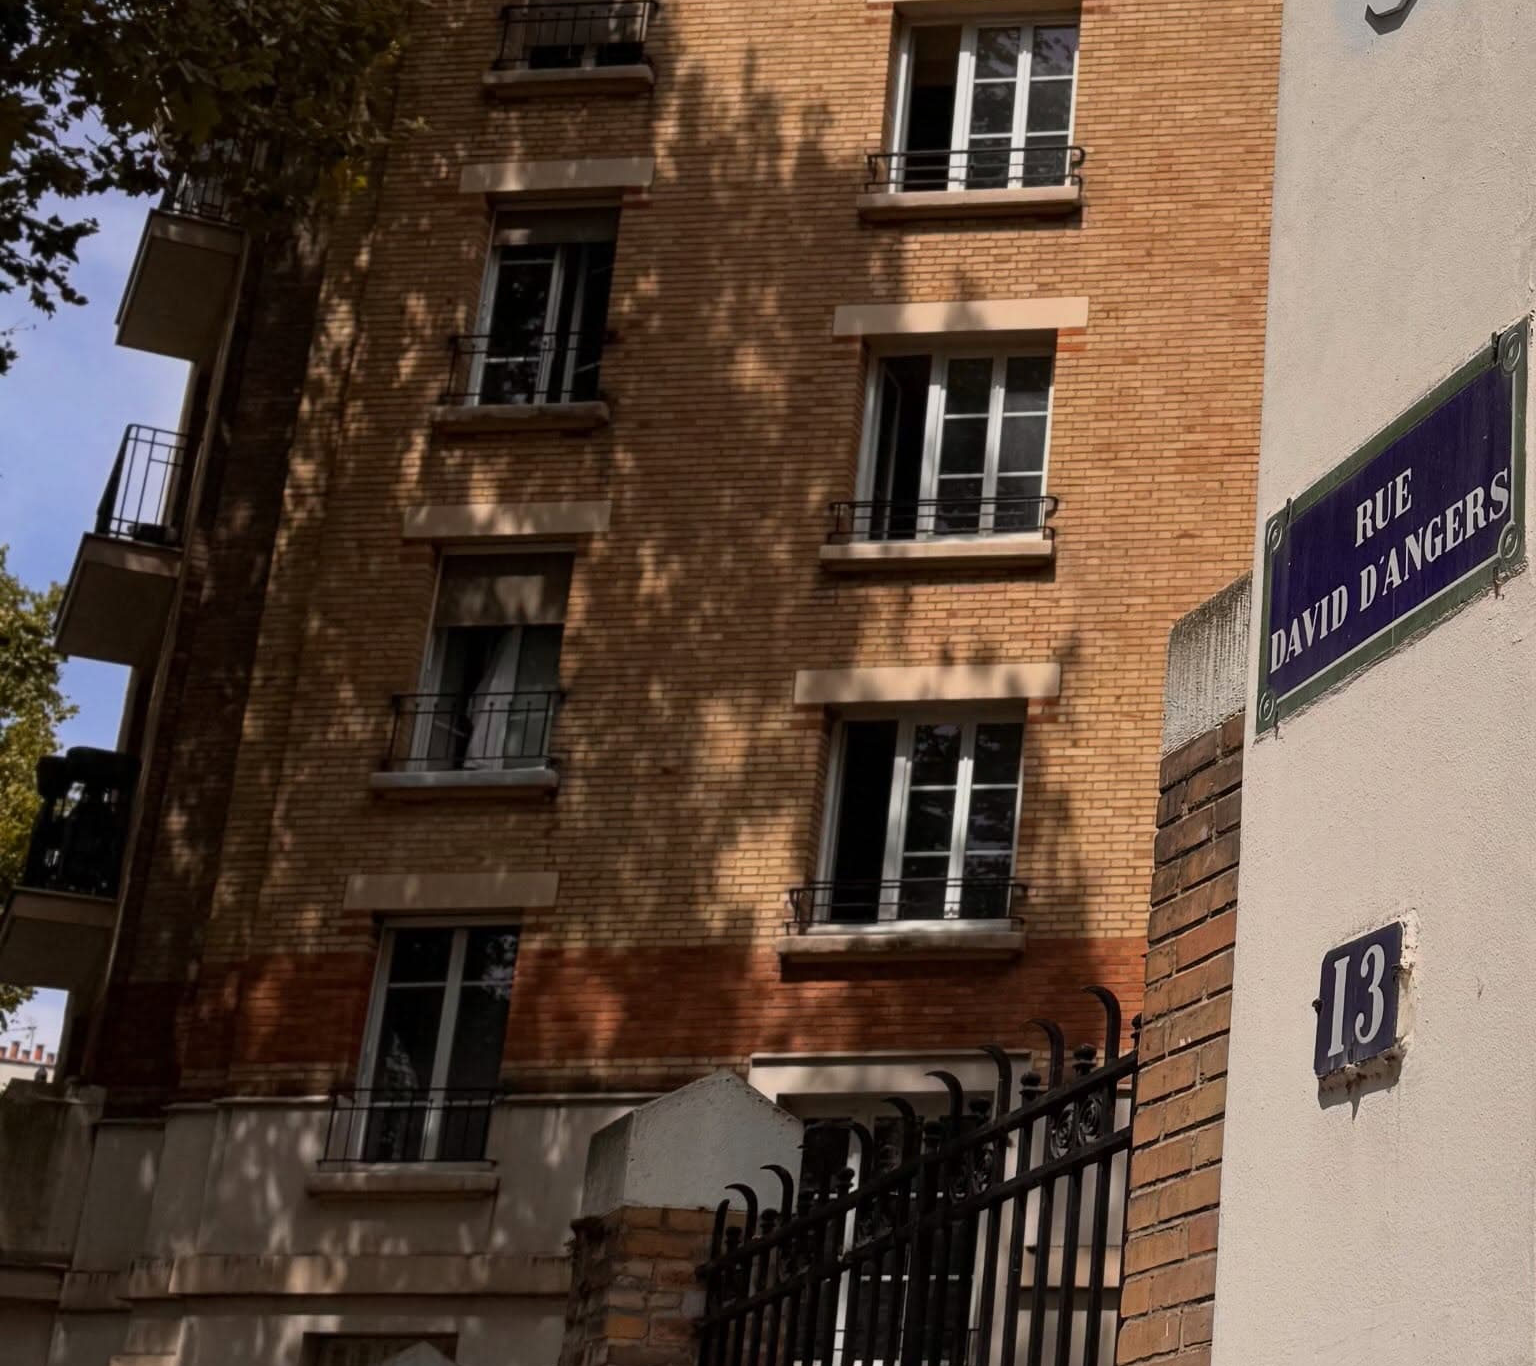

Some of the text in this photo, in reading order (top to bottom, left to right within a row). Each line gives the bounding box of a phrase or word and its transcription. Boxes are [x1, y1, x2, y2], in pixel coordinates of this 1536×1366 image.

[1354, 467, 1413, 548] RUE
[1269, 466, 1511, 674] DAVID D'ANGERS
[1327, 943, 1385, 1058] 13
